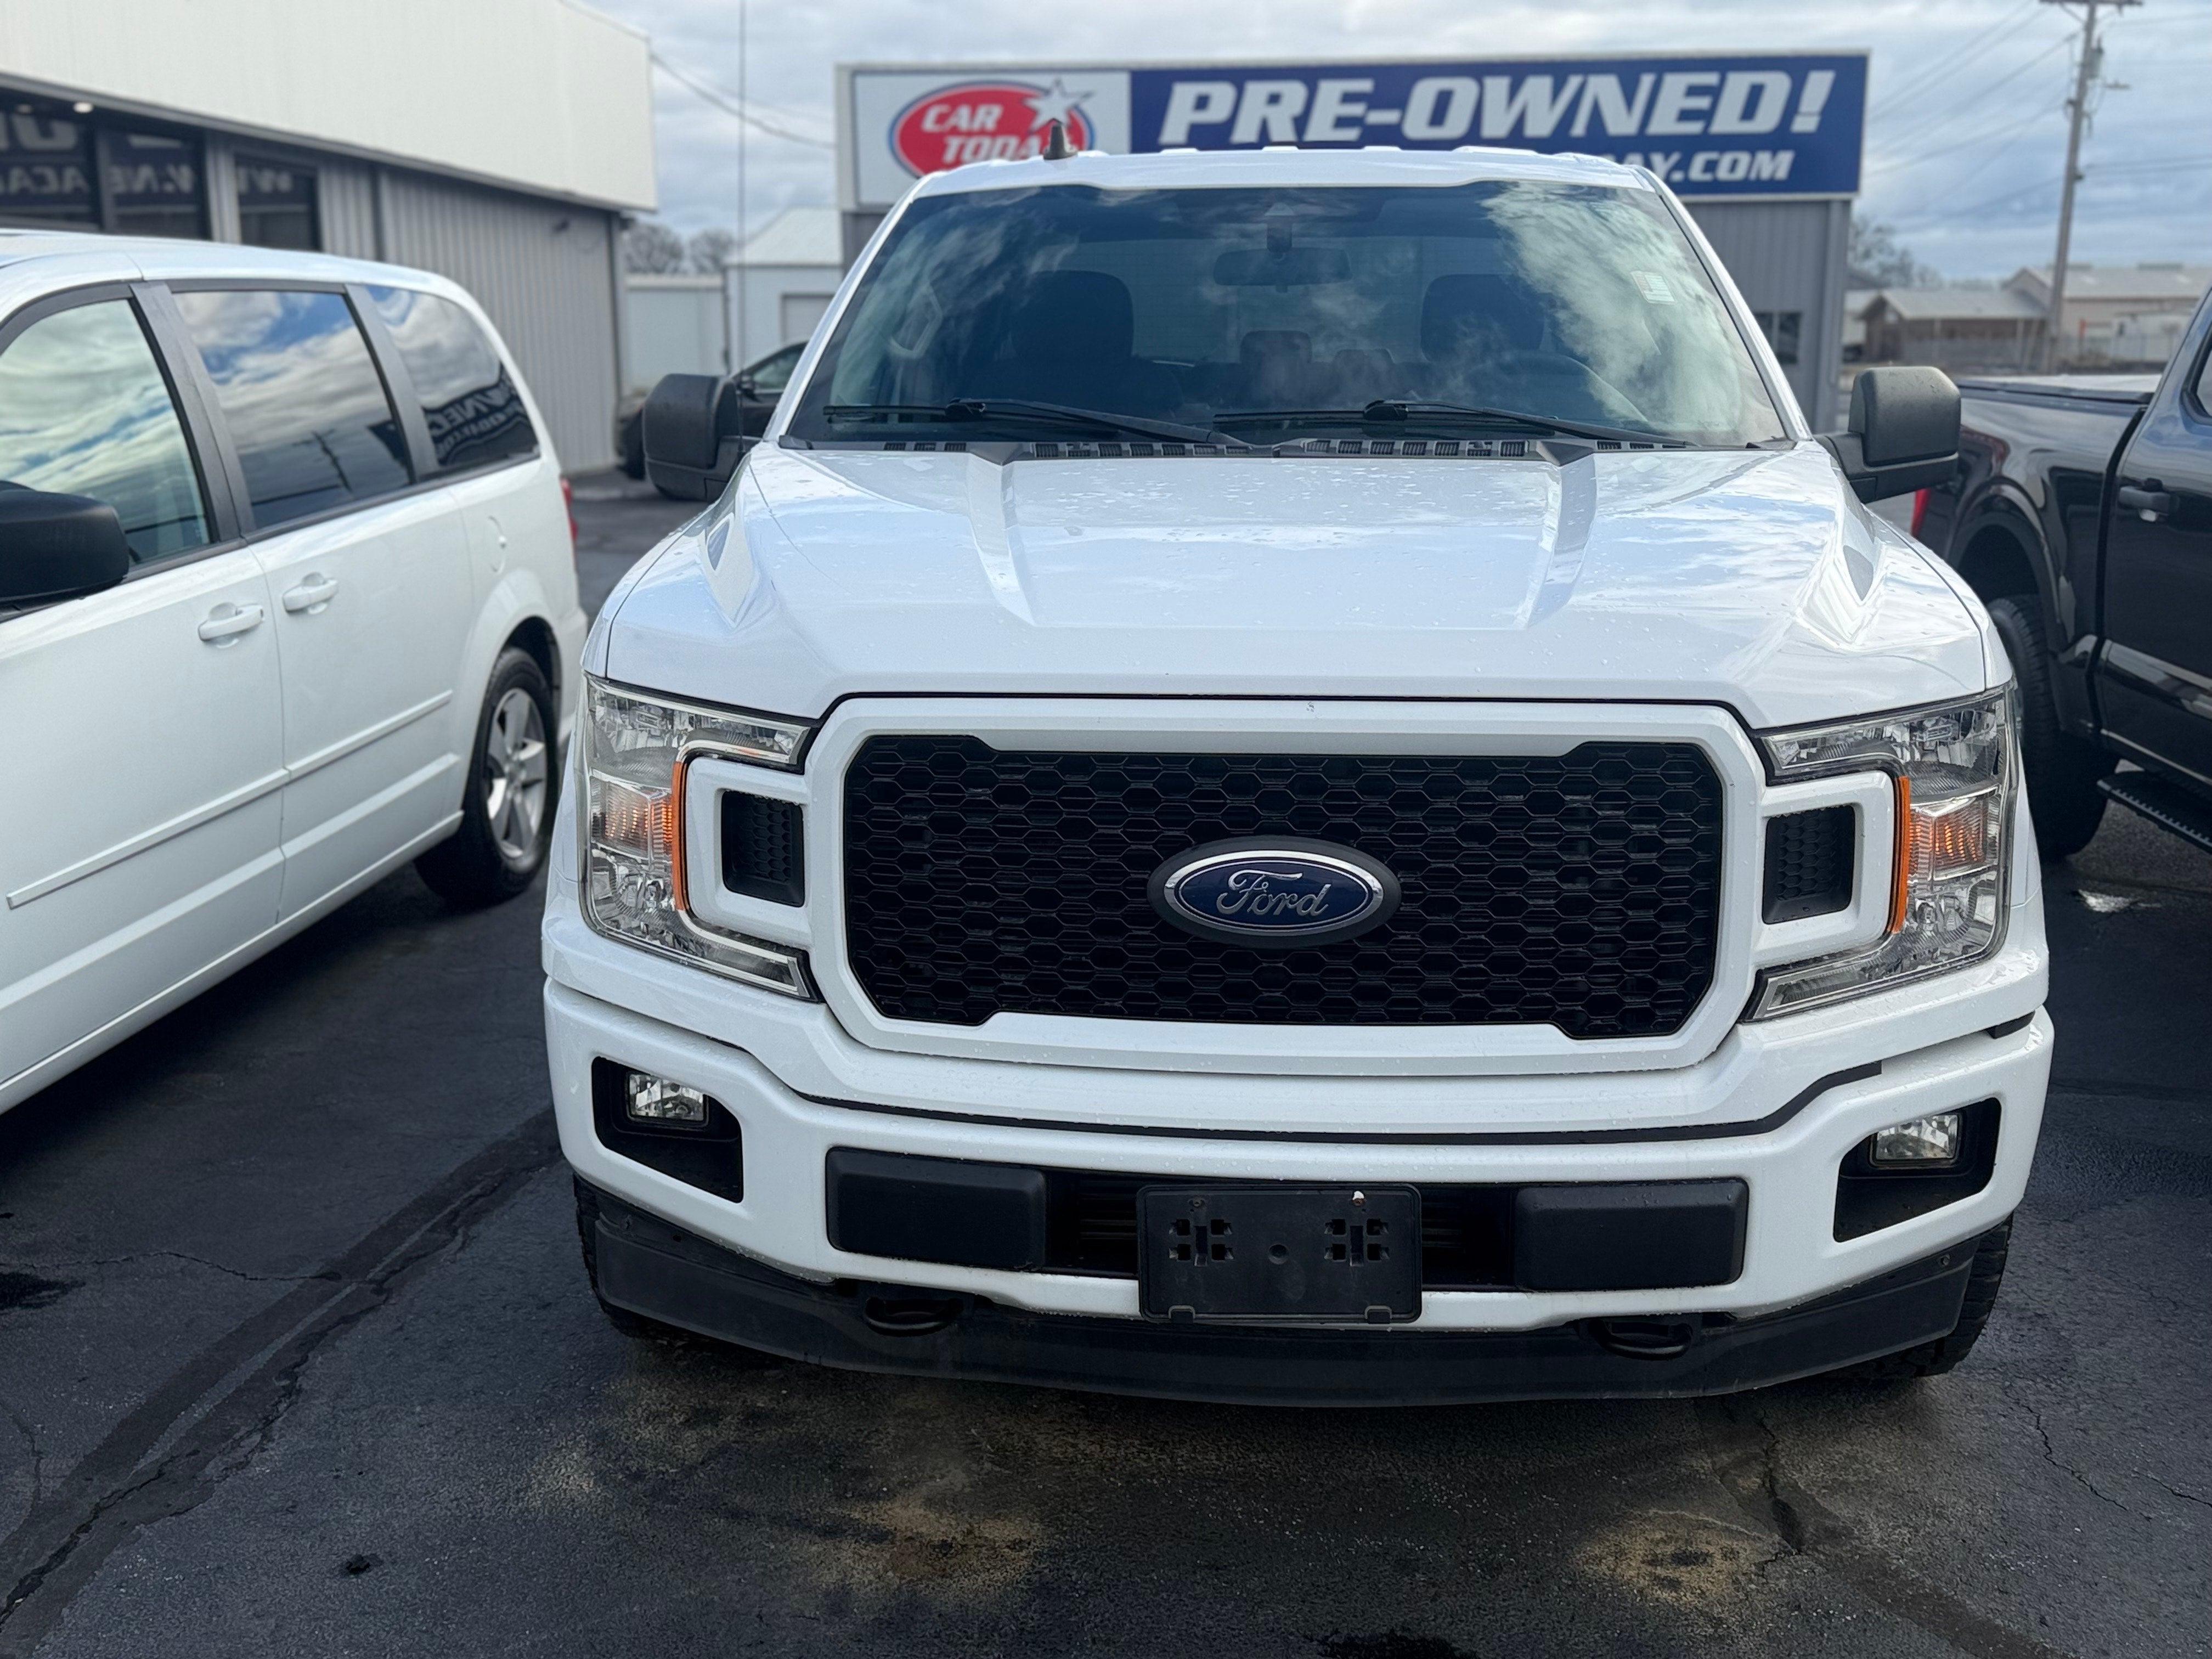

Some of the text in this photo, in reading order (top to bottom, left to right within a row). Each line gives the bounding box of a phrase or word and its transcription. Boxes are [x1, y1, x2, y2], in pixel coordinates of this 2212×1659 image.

[921, 104, 1003, 132] CAR
[1158, 70, 1836, 144] PRE-OWNED!
[941, 136, 1043, 164] TODA
[1216, 869, 1331, 916] Ford
